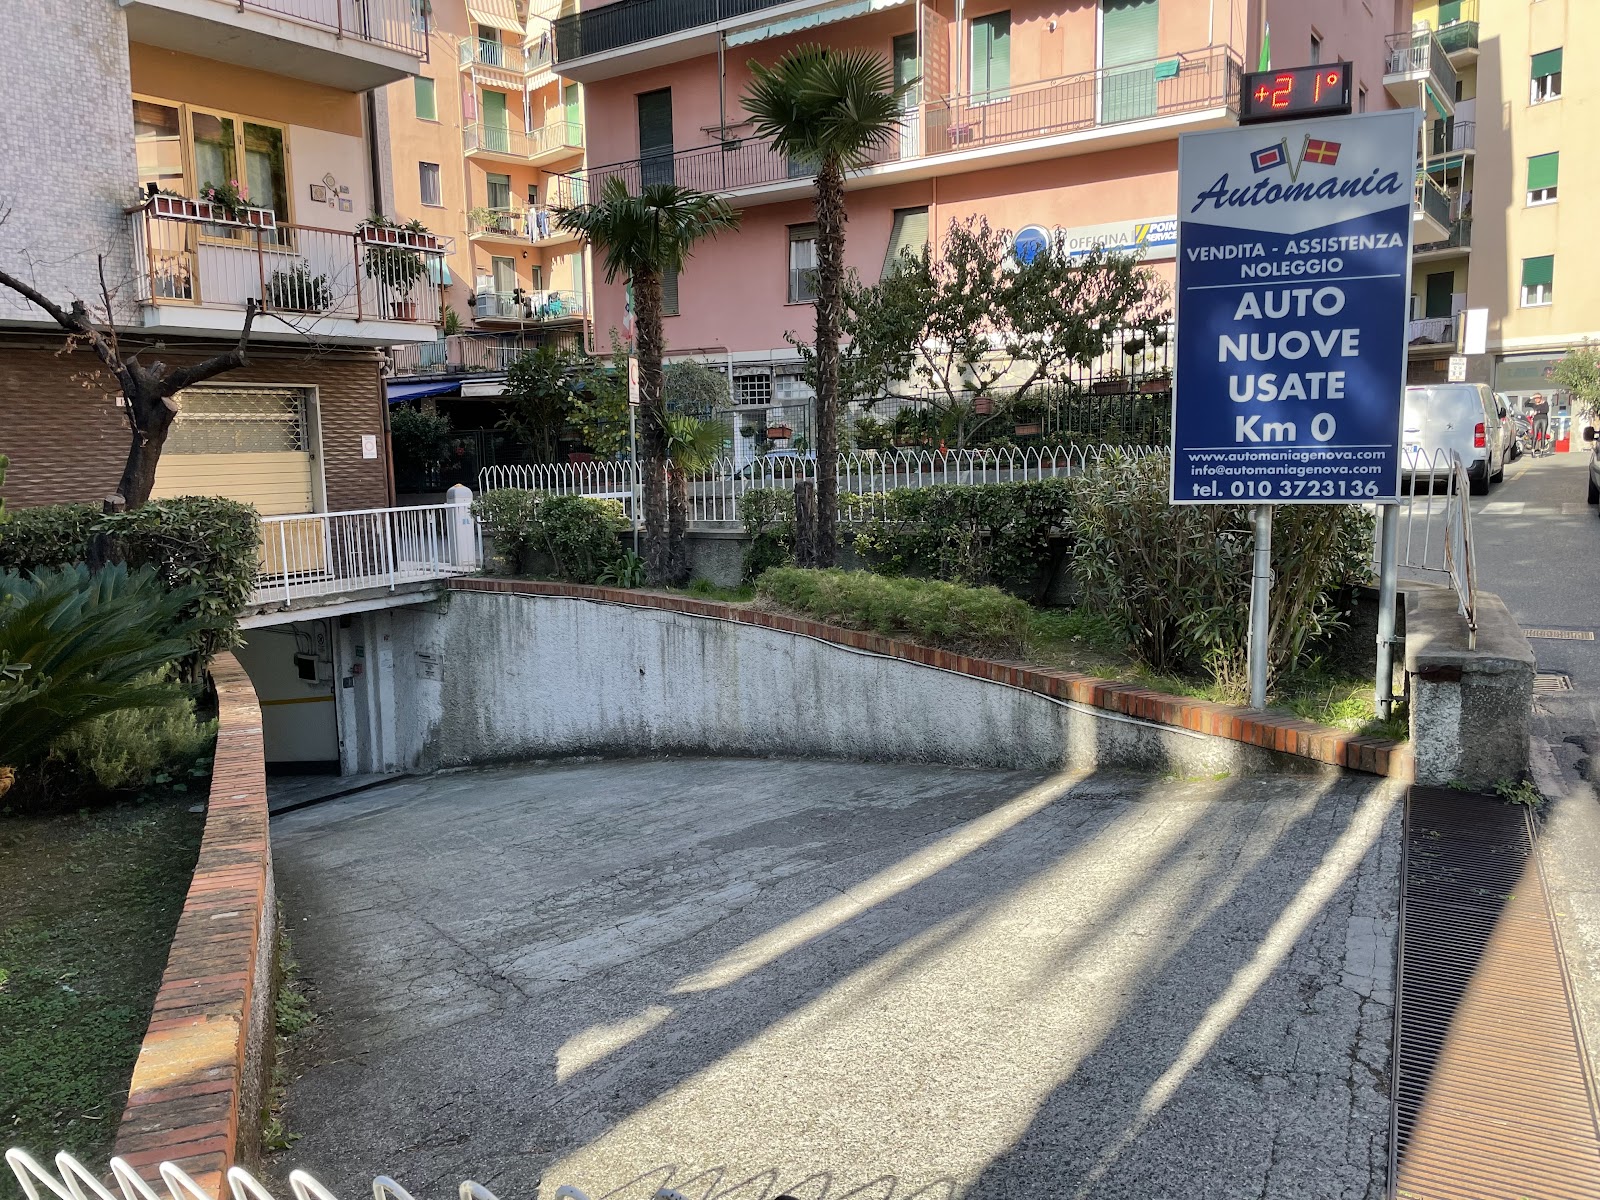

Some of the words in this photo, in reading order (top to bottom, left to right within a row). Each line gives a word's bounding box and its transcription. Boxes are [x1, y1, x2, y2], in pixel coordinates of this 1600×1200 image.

[1190, 167, 1403, 214] Automania
[1149, 220, 1177, 233] POIN
[1070, 232, 1128, 249] OFFICINA
[1187, 242, 1266, 262] VENDITA
[1285, 232, 1404, 256] ASSISTENZA
[1240, 257, 1344, 279] NOLEGGIO
[1233, 286, 1346, 321] AUTO
[1218, 328, 1361, 362] NUOVE
[1229, 371, 1346, 403] USATE
[1235, 415, 1297, 443] Km
[1310, 412, 1337, 442] 0
[1188, 450, 1386, 463] www.automaniagenova.com
[1191, 464, 1382, 477] info@automaniagenova.com
[1192, 481, 1224, 497] tel.
[1230, 481, 1272, 497] 010
[1278, 480, 1379, 498] 3723136
